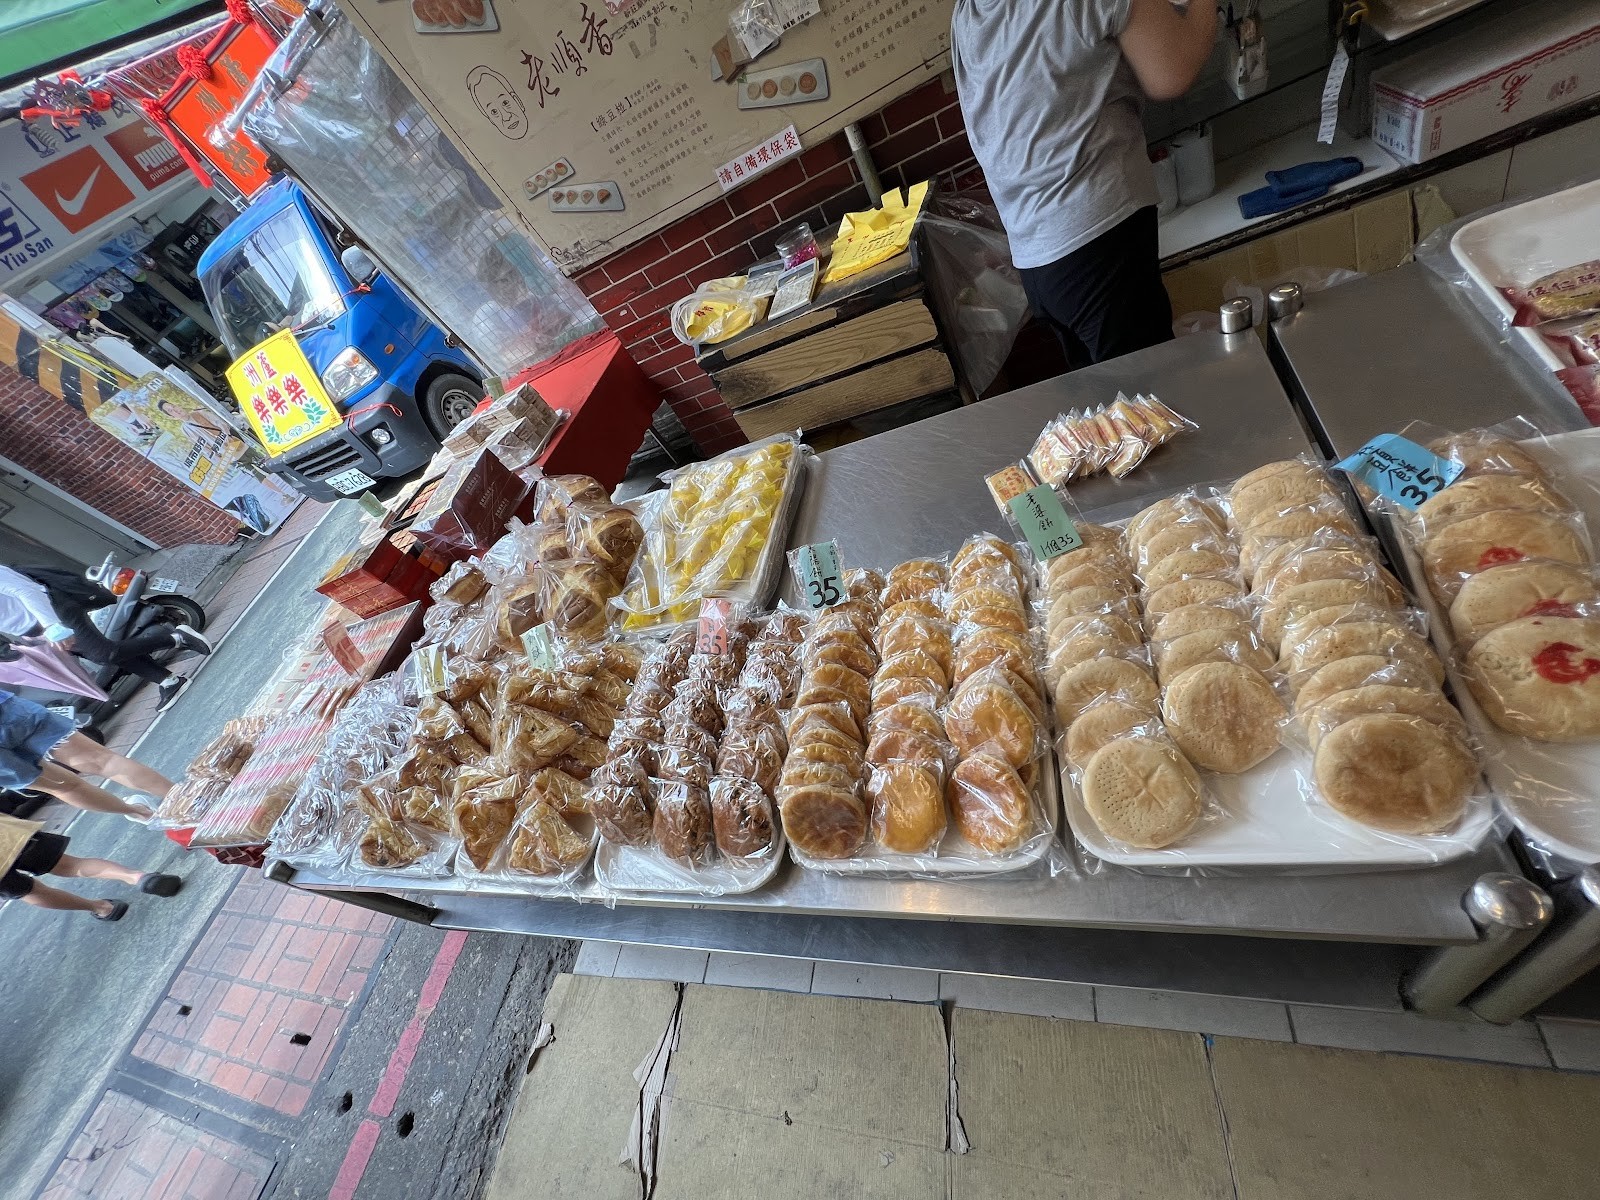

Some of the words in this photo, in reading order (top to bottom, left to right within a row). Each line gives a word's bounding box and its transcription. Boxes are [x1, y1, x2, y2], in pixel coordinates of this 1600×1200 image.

[521, 2, 613, 107] 老順香
[133, 139, 178, 172] PUMA
[149, 157, 184, 181] puma.com
[719, 132, 799, 184] 請自備環保袋
[0, 253, 28, 270] Yiu
[24, 236, 53, 258] San
[250, 373, 307, 422] 樂樂樂
[1401, 468, 1444, 504] 35
[1025, 492, 1053, 530] 老婆餅
[808, 576, 839, 608] 35
